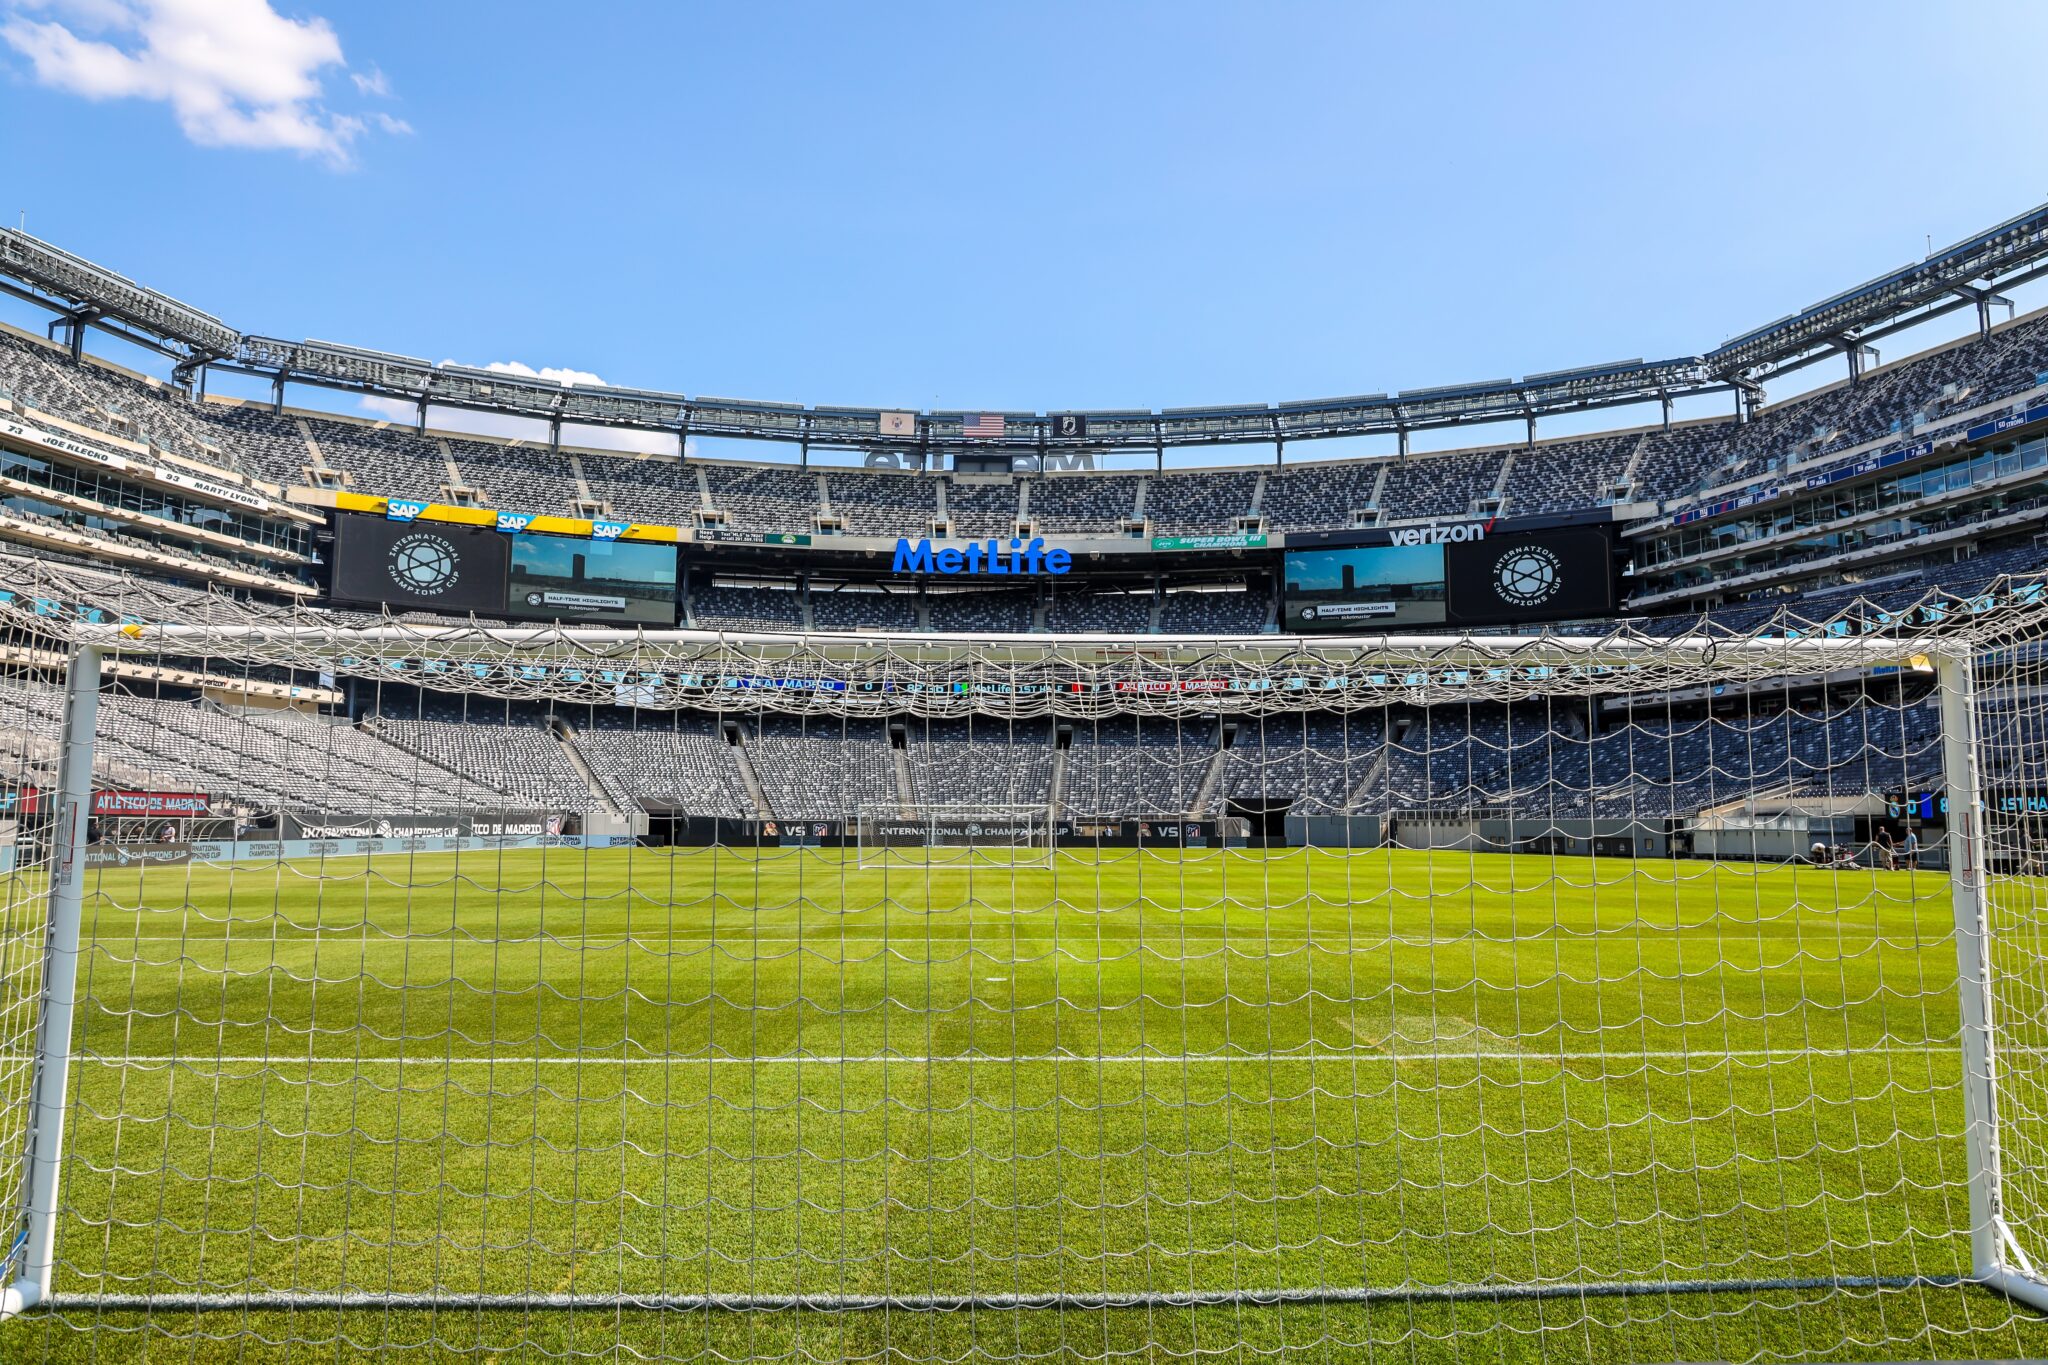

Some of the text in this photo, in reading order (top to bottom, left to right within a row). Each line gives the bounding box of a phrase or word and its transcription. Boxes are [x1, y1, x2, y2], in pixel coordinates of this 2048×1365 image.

[7, 425, 108, 461] 73 JOE KLECKO
[166, 474, 260, 506] 93 MARTY LYONS
[388, 502, 420, 518] SAP
[498, 516, 528, 530] SAP
[594, 525, 621, 538] SAP
[1389, 522, 1484, 546] verizon
[389, 534, 460, 564] INTERNATIONAL
[892, 538, 1072, 574] MetLife
[1494, 546, 1562, 574] INTERNATIONAL
[388, 565, 460, 596] CHAMPIONS CUP
[1494, 576, 1562, 606] CHAMPIONS CUP
[97, 796, 205, 810] ATLETICO DE MADRID
[2002, 798, 2024, 810] 1ST
[394, 827, 442, 838] CHAMPIONS
[444, 826, 459, 838] CUP
[492, 824, 502, 834] DE
[506, 824, 542, 834] MADRID
[785, 826, 806, 836] VS
[880, 828, 963, 836] INTERNATIONAL
[984, 828, 1047, 836] CHAMPIONS
[1158, 826, 1178, 837] VS
[131, 850, 173, 859] CHAMPIONS
